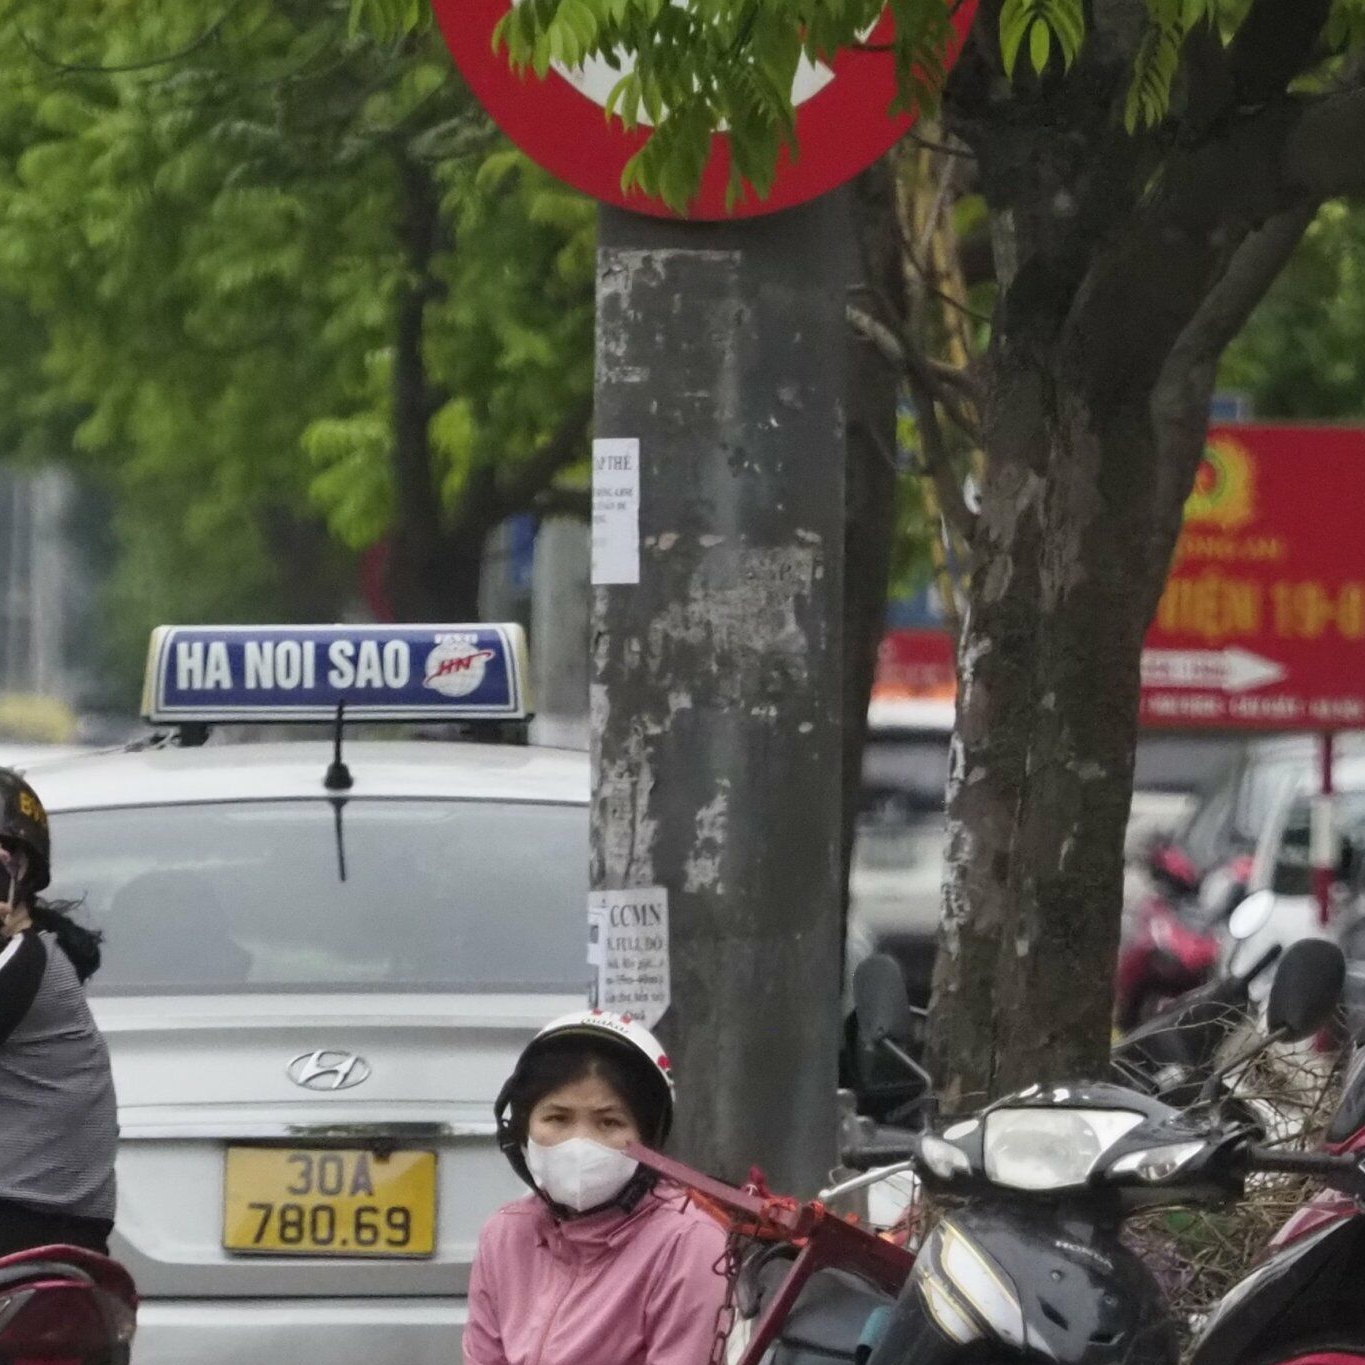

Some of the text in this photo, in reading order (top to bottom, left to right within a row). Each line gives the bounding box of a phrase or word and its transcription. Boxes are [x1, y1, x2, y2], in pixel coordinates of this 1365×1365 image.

[176, 639, 411, 690] HA NOI SAO
[610, 903, 662, 927] CCMN
[287, 1153, 375, 1197] 30A
[247, 1202, 412, 1247] 780.69
